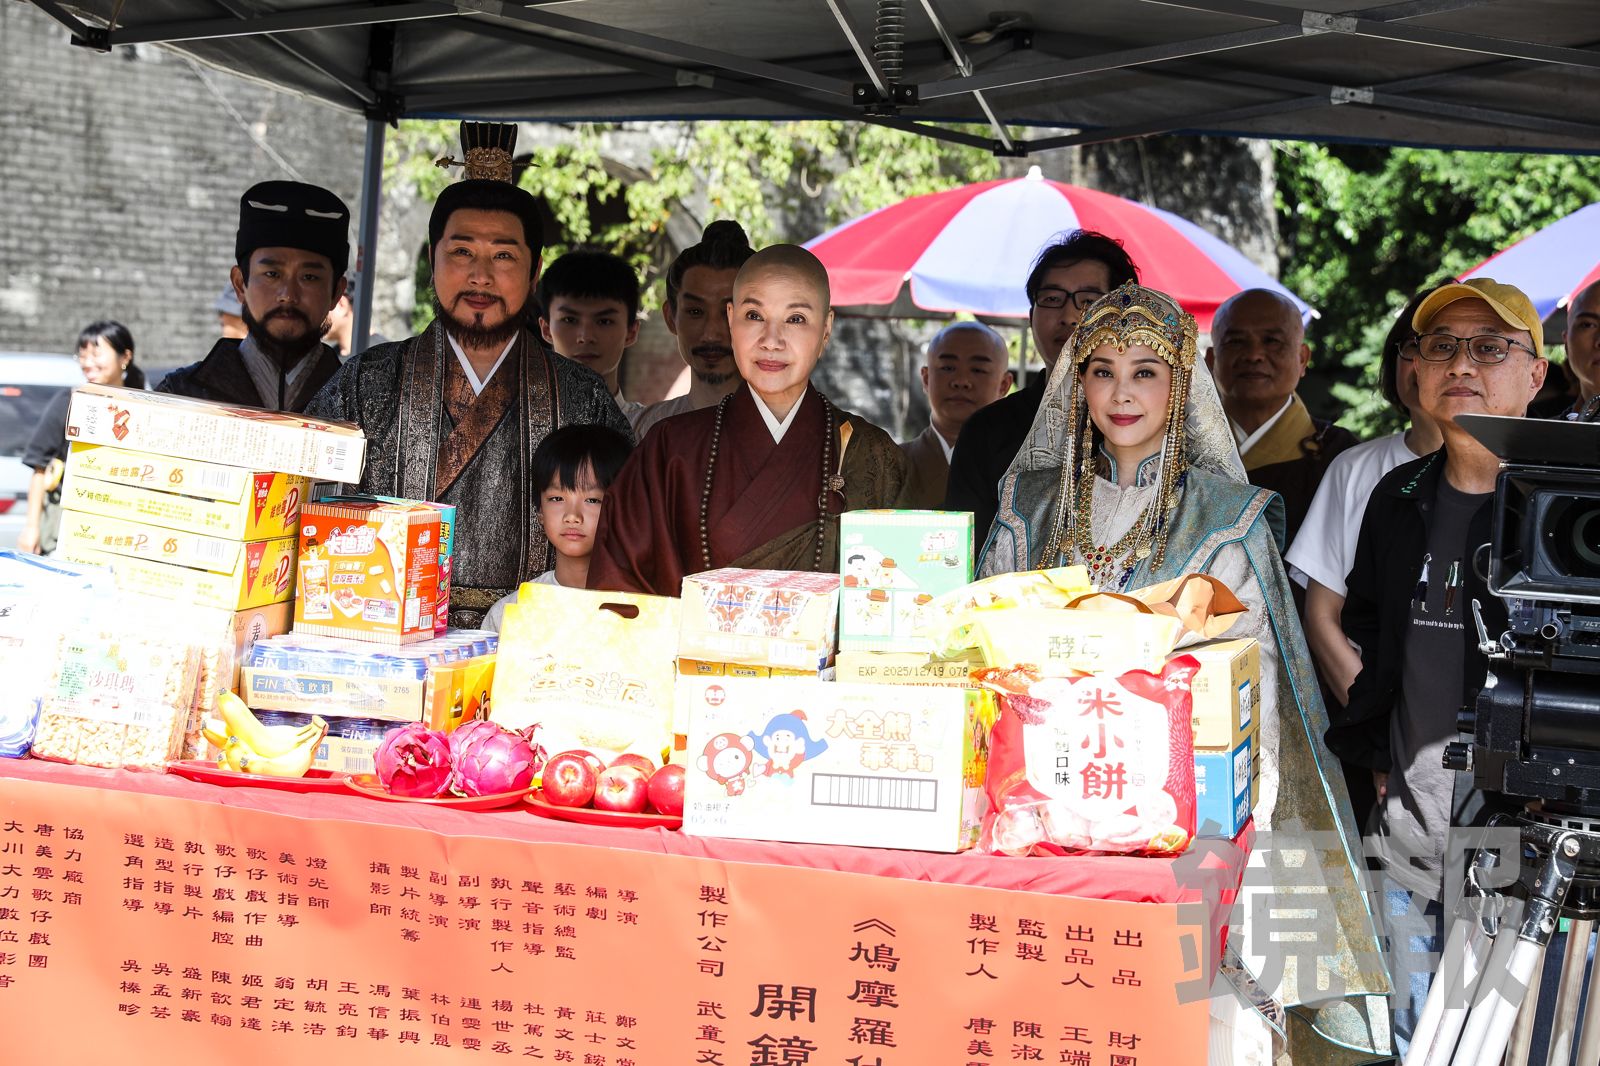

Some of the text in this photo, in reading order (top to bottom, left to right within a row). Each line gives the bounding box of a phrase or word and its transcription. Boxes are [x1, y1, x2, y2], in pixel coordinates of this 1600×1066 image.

[326, 534, 375, 554] 卡迪那
[88, 670, 135, 694] 沙琪瑪
[254, 657, 279, 669] FIN
[255, 680, 279, 691] FIN
[394, 686, 410, 695] 2765
[858, 666, 968, 678] EXP 2025/12/19 078
[341, 730, 367, 740] FIN
[1078, 687, 1129, 800] 米小餅
[62, 827, 84, 905] 協力廠商
[123, 833, 144, 911] 選角指導
[154, 837, 175, 915] 造型指導
[182, 841, 205, 919] 執行製片
[277, 852, 299, 927] 美術指導
[306, 857, 329, 909] 燈光師
[370, 861, 391, 916] 攝影師
[28, 824, 54, 968] 唐美雲歌仔戲團
[212, 844, 237, 945] 歌仔戲編腔
[244, 848, 268, 946] 歌仔戲作曲
[400, 865, 420, 942] 製片統籌
[428, 871, 448, 928] 副導演
[458, 875, 480, 930] 副導演
[521, 881, 545, 955] 聲音指導
[553, 883, 576, 960] 藝術總監
[585, 886, 607, 920] 編劇
[617, 889, 638, 925] 導演
[490, 877, 514, 973] 執行製作人
[697, 885, 728, 977] 製作公司
[965, 913, 998, 979] 製作人
[1015, 919, 1047, 962] 監製
[1061, 925, 1095, 988] 出品人
[1112, 930, 1142, 986] 出品
[150, 963, 172, 1019] 吳孟芸
[181, 967, 202, 1022] 盛新豪
[211, 971, 232, 1027] 陳歆翰
[241, 974, 263, 1031] 姬君達
[272, 977, 295, 1033] 翁定洋
[303, 978, 328, 1035] 胡毓浩
[336, 982, 360, 1038] 王亮鈞
[367, 985, 390, 1040] 馮信華
[398, 987, 421, 1044] 葉振興
[430, 993, 451, 1047] 林伯恩
[460, 997, 482, 1051] 連雯雯
[491, 1000, 514, 1054] 楊世丞
[523, 1003, 544, 1058] 杜篤之
[554, 1007, 575, 1062] 黃文英
[696, 1001, 726, 1066] 武童文
[747, 984, 818, 1066] 開鏡
[1011, 1021, 1044, 1060] 陳淑
[1060, 1026, 1093, 1066] 王端
